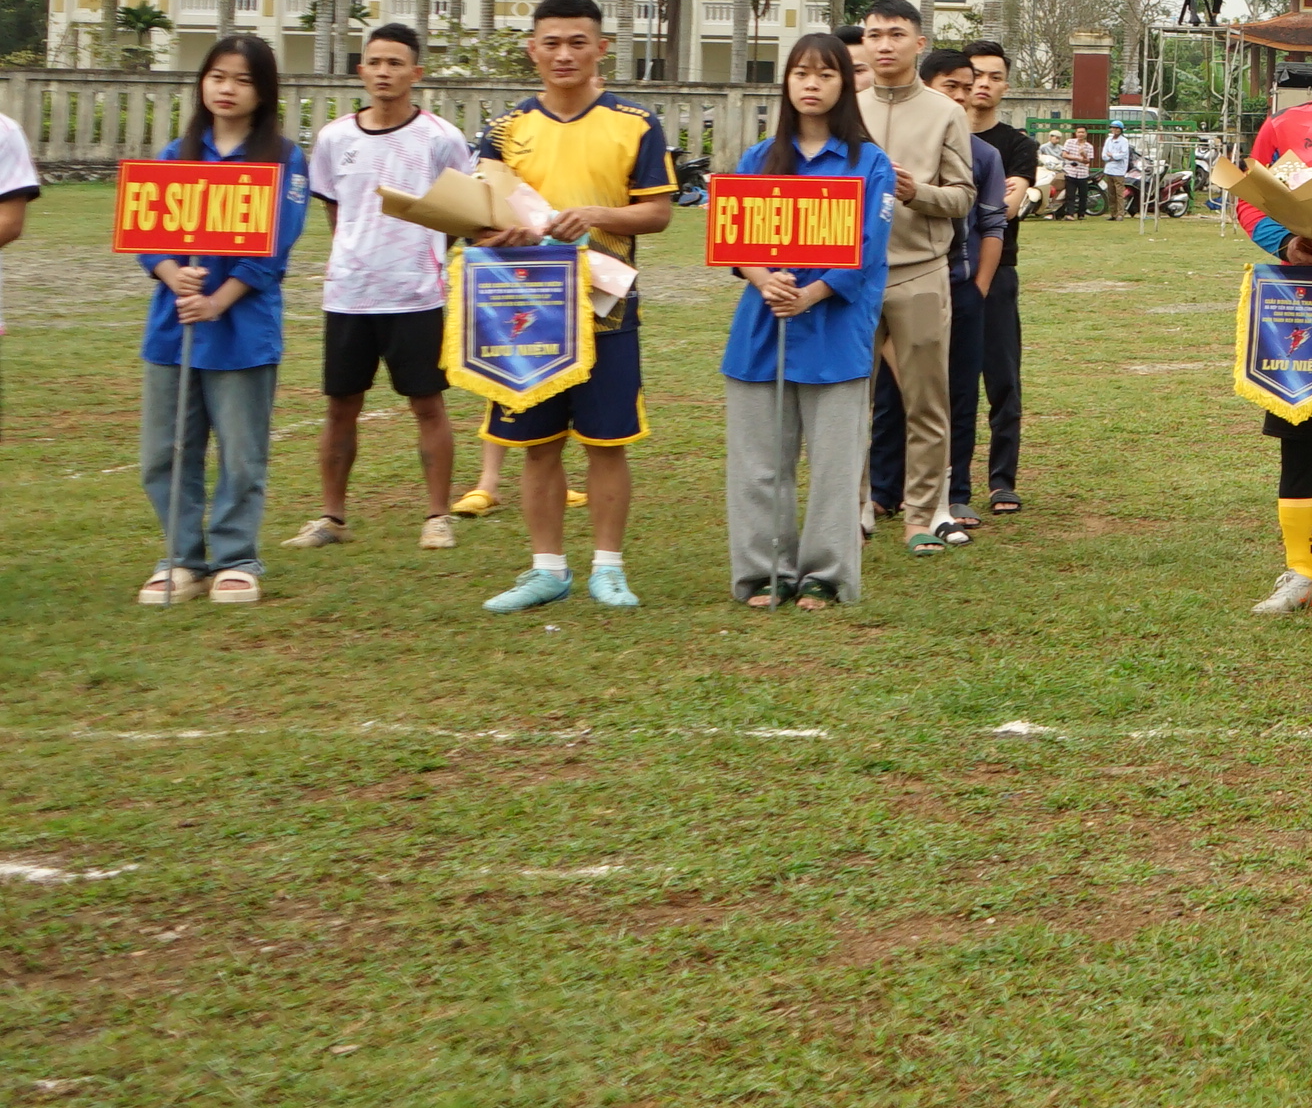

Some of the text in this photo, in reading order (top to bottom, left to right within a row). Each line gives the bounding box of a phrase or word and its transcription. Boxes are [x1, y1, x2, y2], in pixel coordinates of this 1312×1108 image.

[122, 174, 272, 244] FC SỰ KIỆN
[714, 187, 856, 256] FC TRIỆU THÀNH
[1262, 359, 1290, 370] LƯU
